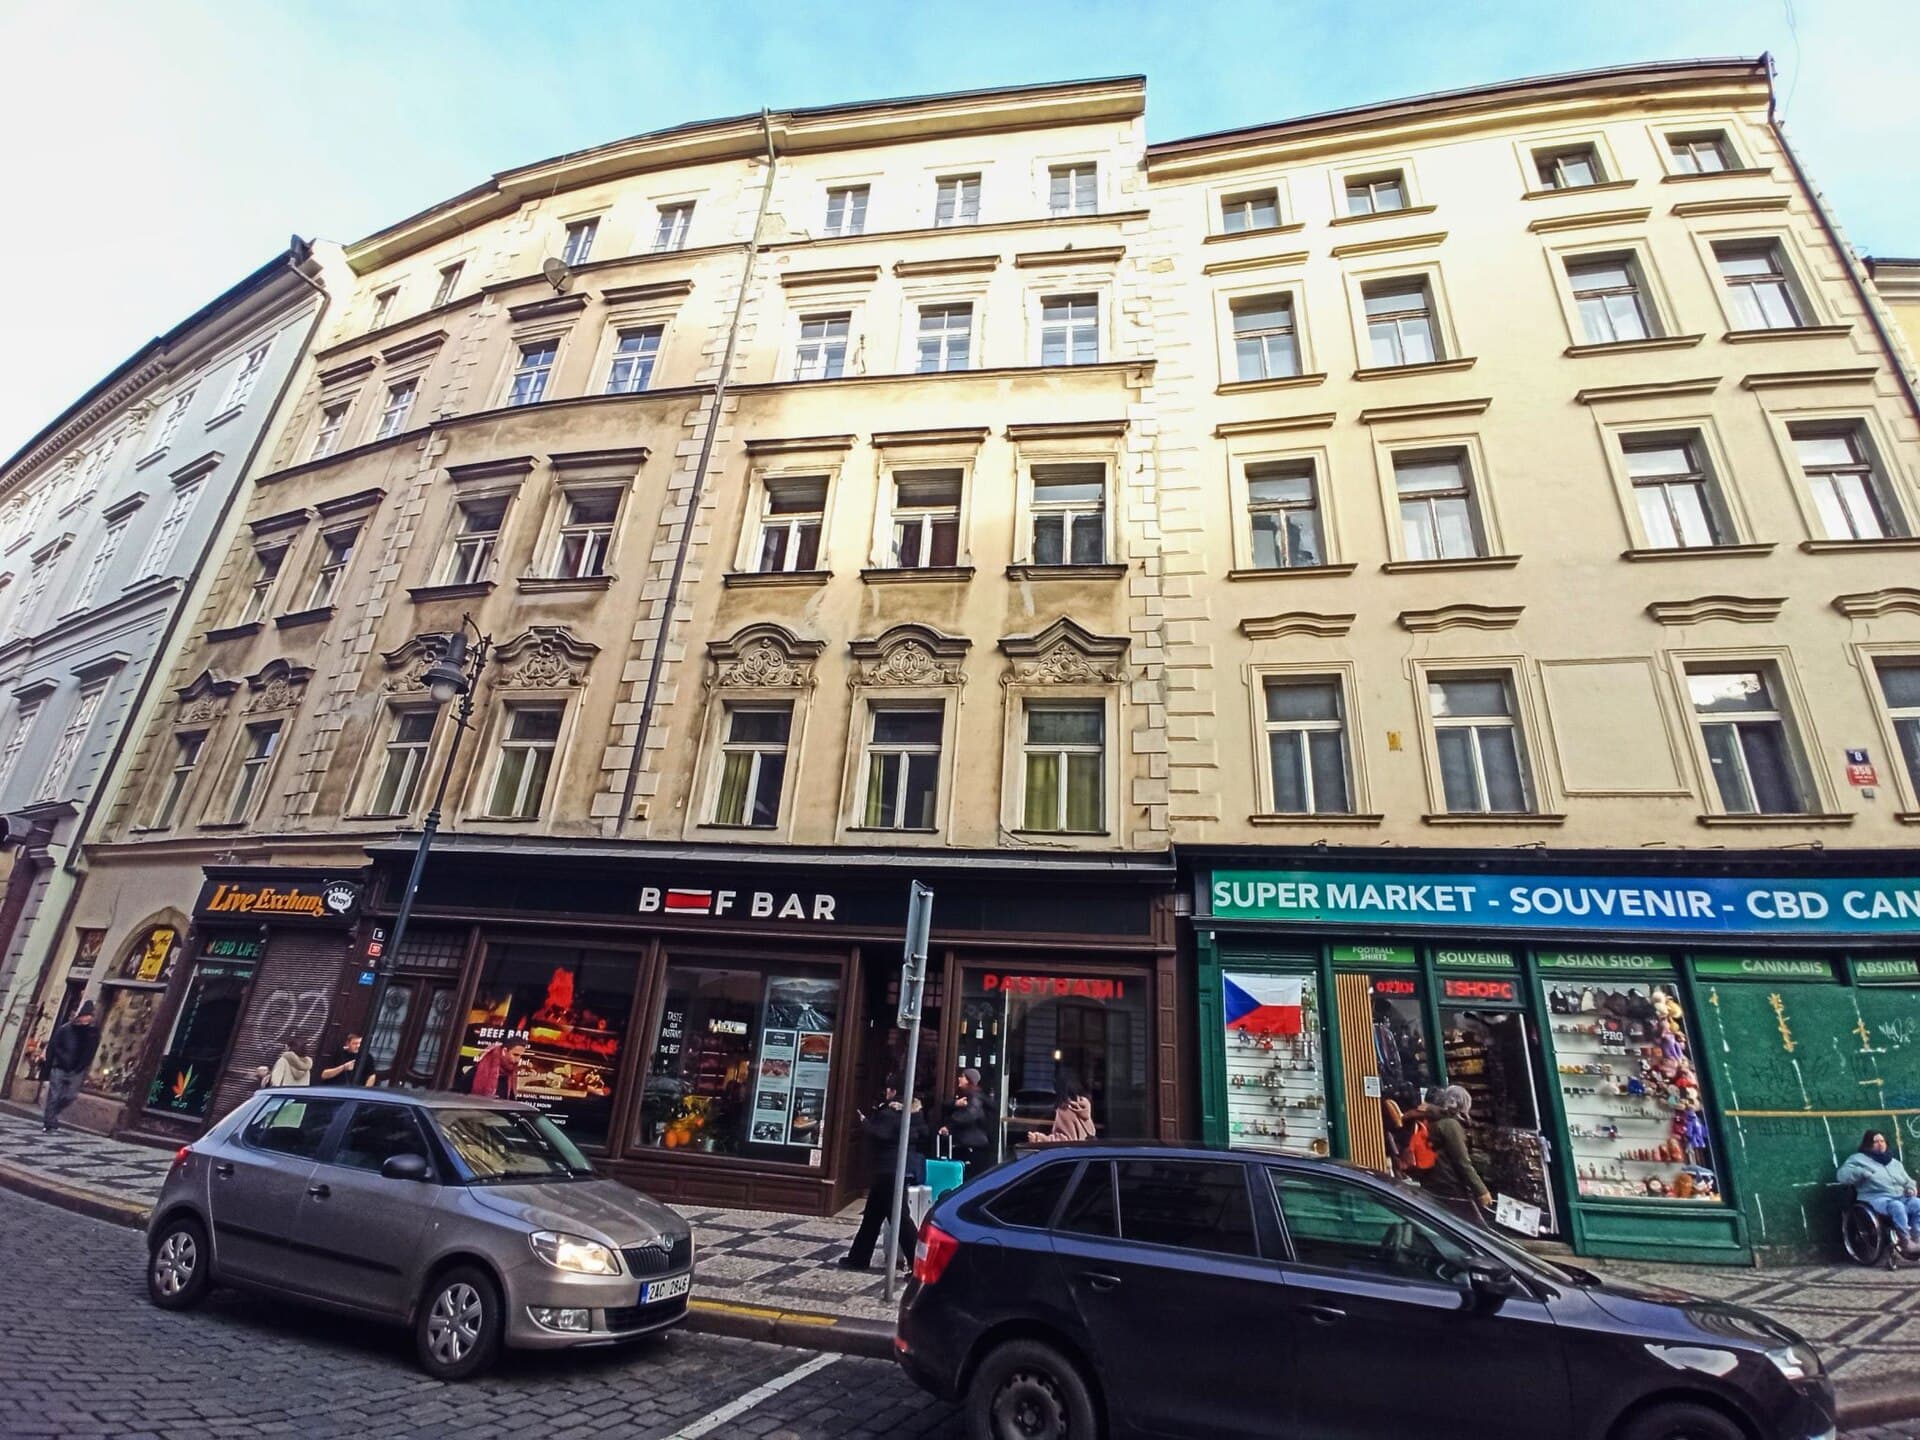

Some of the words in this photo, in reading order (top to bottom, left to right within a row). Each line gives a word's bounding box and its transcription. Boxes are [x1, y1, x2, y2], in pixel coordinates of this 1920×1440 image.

[206, 884, 257, 913] Live
[1213, 881, 1320, 910] SUPER
[1327, 883, 1477, 912] MARKET
[1511, 886, 1717, 919] SOUVENIR
[1746, 890, 1830, 920] CBD
[1843, 890, 1920, 920] CAN
[751, 891, 837, 922] BAR
[213, 939, 236, 956] CBD
[236, 941, 260, 958] LIFE
[1352, 945, 1395, 954] FOOTBALL
[1359, 952, 1388, 961] SHIRTS
[1438, 951, 1511, 965] SOUVENIR
[1555, 954, 1607, 968] ASIAN
[1609, 955, 1654, 969] SHOP
[1741, 959, 1824, 974] CANNABIS
[1856, 961, 1918, 975] ABSINTH
[983, 973, 1124, 1000] PASTRAMI
[479, 1027, 506, 1039] BEEF
[507, 1029, 530, 1041] BAR
[1602, 1030, 1625, 1042] PRG
